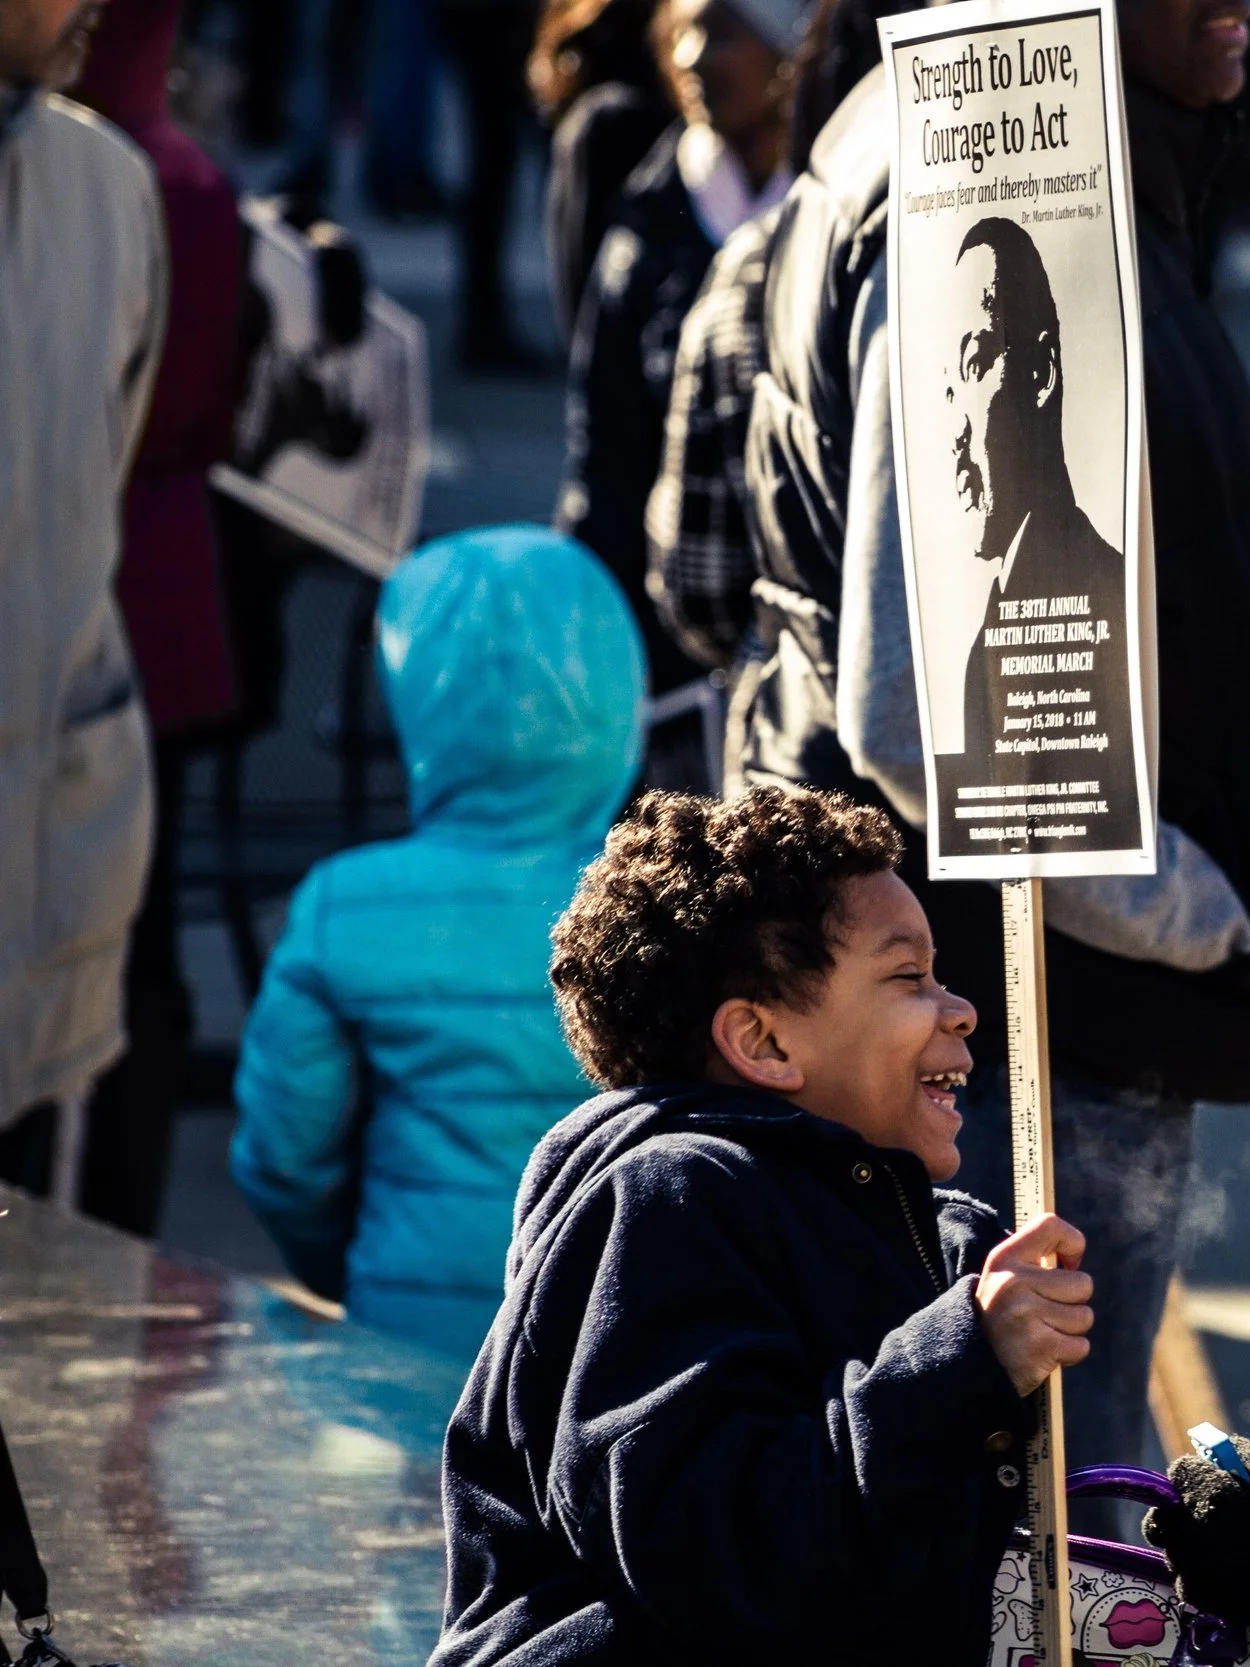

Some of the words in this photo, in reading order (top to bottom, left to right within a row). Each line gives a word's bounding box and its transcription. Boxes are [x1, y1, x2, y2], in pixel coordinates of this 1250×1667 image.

[911, 43, 984, 110] Strength
[989, 45, 1012, 91] to
[1017, 38, 1078, 88] Love,
[922, 117, 996, 173] Courage
[1000, 111, 1025, 155] to
[1030, 102, 1069, 152] Act
[956, 182, 976, 213] fear
[977, 176, 998, 203] and
[999, 172, 1042, 203] thereby
[1043, 171, 1087, 195] masters
[1021, 211, 1032, 225] Dr.
[1032, 208, 1054, 223] Martin
[1055, 205, 1077, 220] Luther
[1077, 204, 1095, 220] King,
[1095, 202, 1104, 219] Jr.
[998, 600, 1019, 620] THE
[1020, 598, 1047, 619] 38TH
[1048, 595, 1090, 617] ANNUAL
[984, 626, 1023, 647] MARTIN
[1024, 623, 1066, 644] LUTHER
[1066, 621, 1095, 643] KING,
[1095, 620, 1110, 644] JR.
[1000, 654, 1055, 676] MEMORIAL
[1056, 651, 1094, 672] MARCH
[1007, 690, 1036, 710] Raleigh,
[1037, 688, 1058, 705] North
[1059, 688, 1090, 704] Carolina
[1003, 715, 1032, 733] January
[1032, 713, 1044, 730] 15,
[1044, 712, 1064, 728] 2018
[1073, 711, 1083, 727] 11
[1083, 710, 1096, 726] AM
[995, 739, 1013, 754] State
[1013, 737, 1041, 756] Capitol,
[1041, 737, 1080, 751] Downtown
[1080, 732, 1109, 752] Raleigh
